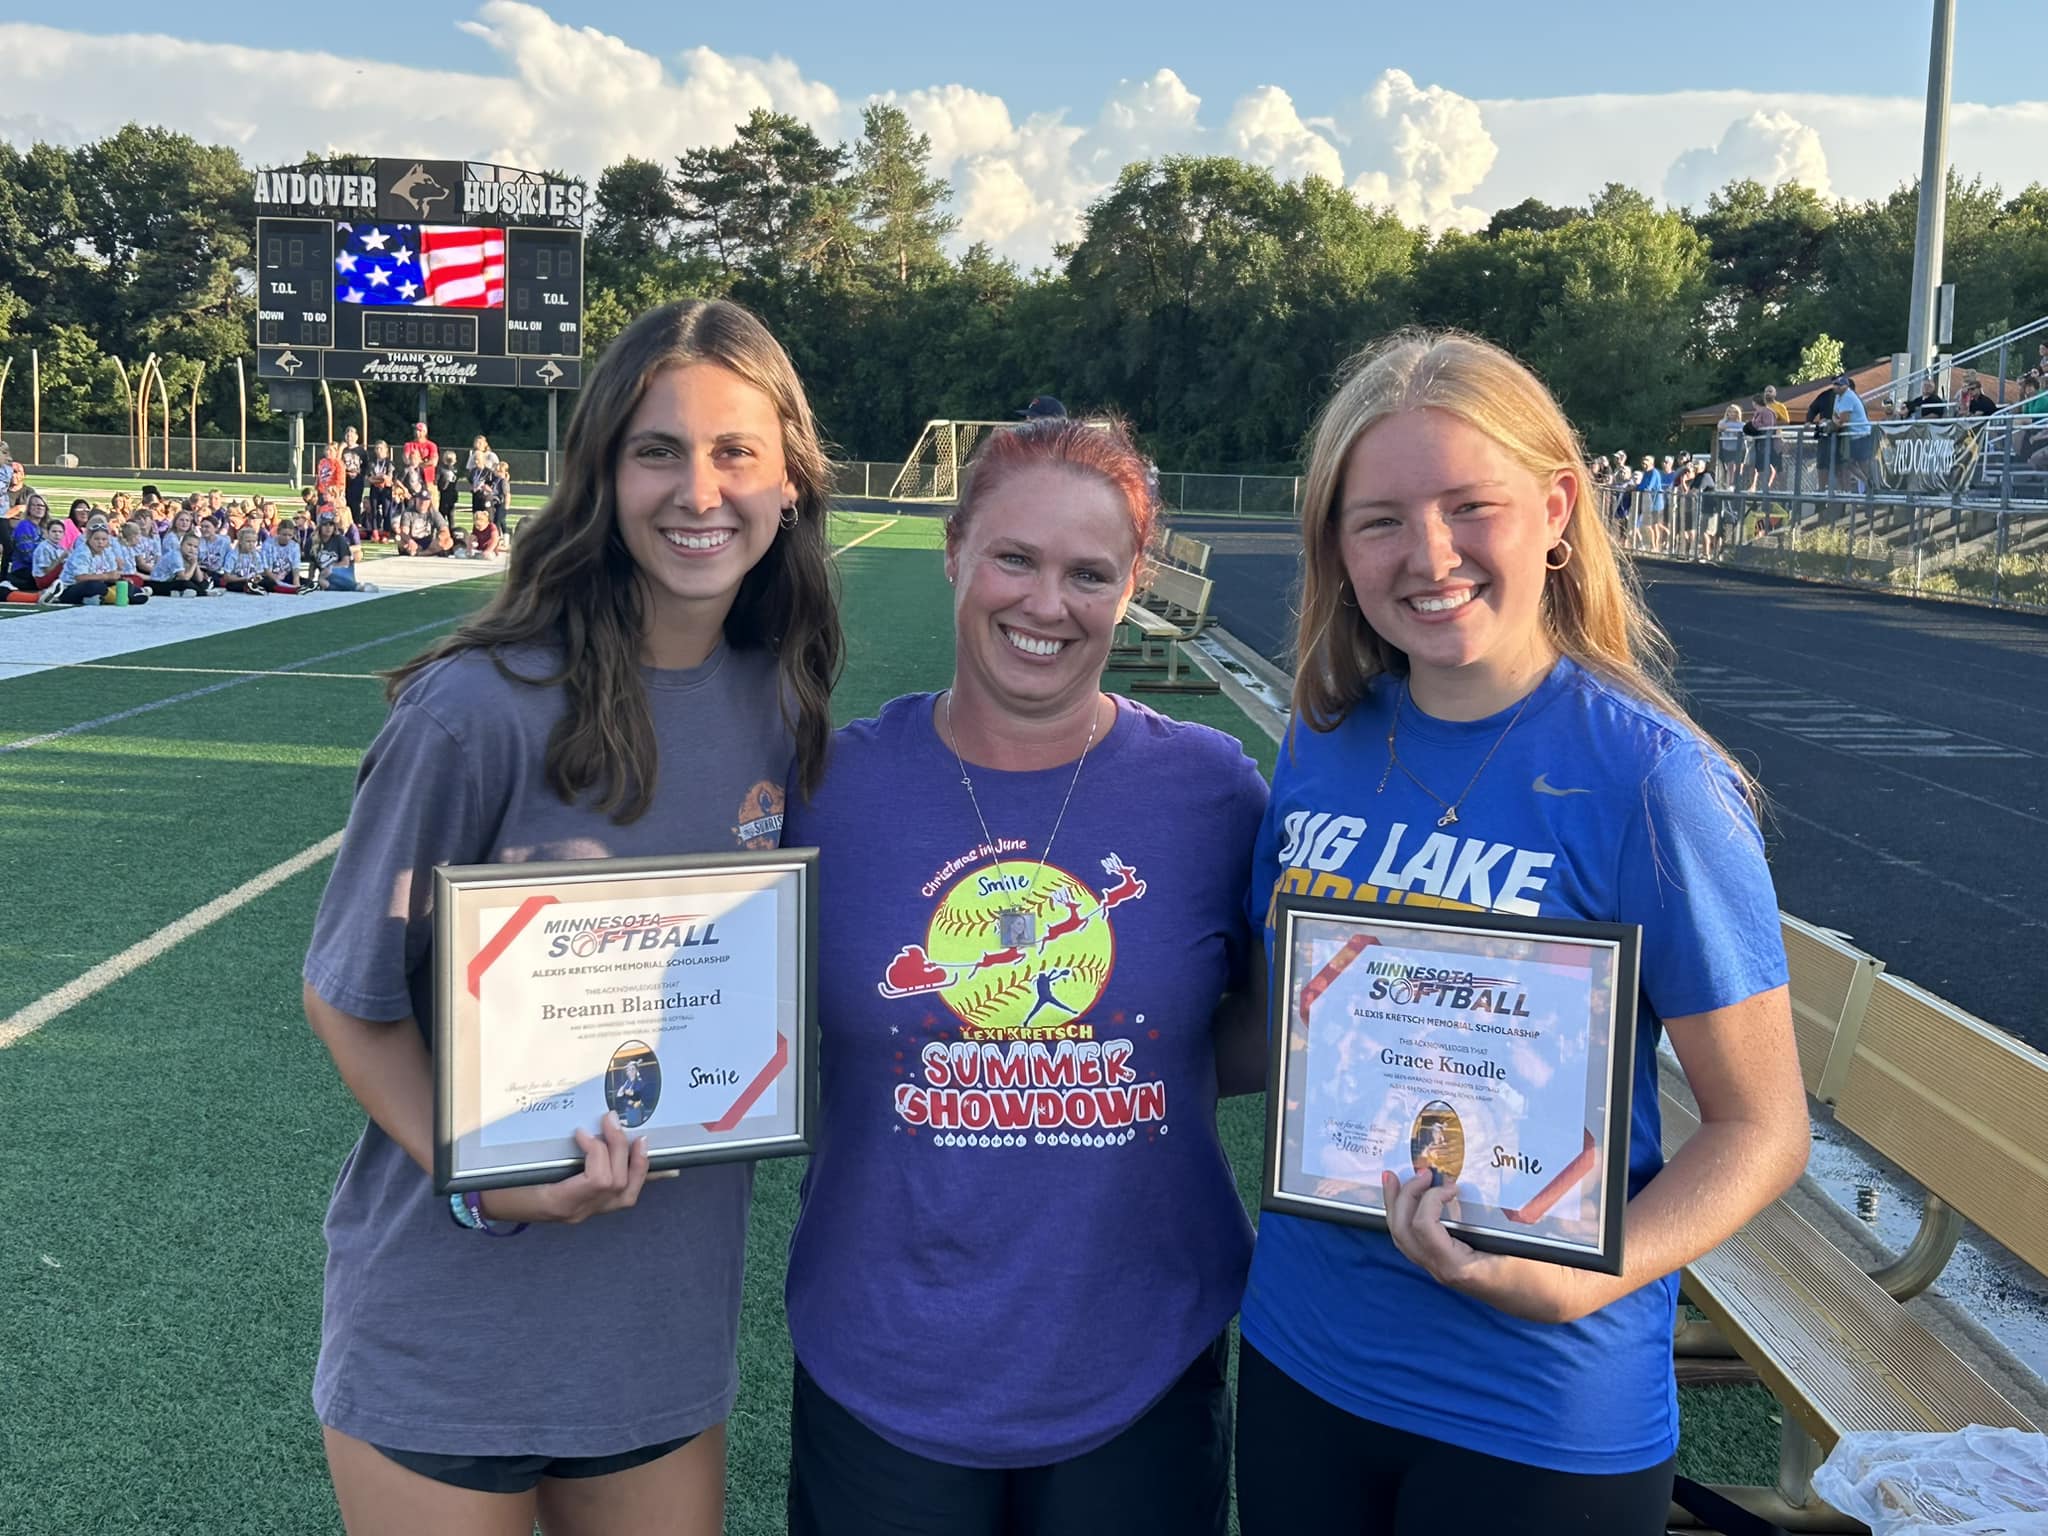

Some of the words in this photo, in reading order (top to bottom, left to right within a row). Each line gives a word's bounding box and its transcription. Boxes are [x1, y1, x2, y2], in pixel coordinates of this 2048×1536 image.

[254, 172, 376, 208] ANDOVER
[463, 181, 583, 217] HUSKIES
[271, 282, 296, 294] T.O.L.
[543, 293, 568, 305] T.O.L.
[260, 310, 284, 322] DOWN
[303, 312, 313, 323] TO
[314, 312, 327, 323] GO
[508, 320, 528, 332] BALL
[529, 321, 542, 332] ON
[560, 322, 577, 333] QTR
[363, 359, 419, 373] Andover
[423, 362, 477, 377] Football
[387, 353, 425, 362] THANK
[430, 354, 453, 364] YOU
[373, 373, 467, 384] ASSOCIATION
[921, 848, 978, 897] Christmas
[978, 844, 993, 857] in
[995, 838, 1027, 854] June
[1279, 811, 1367, 872] BIG
[1368, 822, 1555, 917] LAKE
[978, 875, 1029, 896] Smile
[544, 913, 661, 934] MINNESOTA
[548, 923, 719, 958] SOFTBALL
[531, 967, 567, 978] ALEXIS
[568, 964, 613, 975] KRETSCH
[614, 961, 664, 972] MEMORIAL
[666, 955, 730, 968] SCHOLARSHIP
[1366, 961, 1474, 987] MINNESOTA
[541, 1001, 615, 1021] Breann
[621, 989, 721, 1013] Blanchard
[1369, 977, 1530, 1018] SOFTBALL
[961, 1026, 1003, 1041] LEXI
[1006, 1025, 1094, 1040] KRETSCH
[1354, 1008, 1384, 1020] ALEXIS
[1385, 1013, 1425, 1025] KRETSCH
[1427, 1017, 1473, 1031] MEMORIAL
[1475, 1023, 1540, 1039] SCHOLARSHIP
[922, 1039, 1136, 1088] SUMMER
[1381, 1048, 1433, 1070] Grace
[1438, 1056, 1506, 1080] Knodle
[688, 1066, 739, 1089] Smile
[895, 1080, 1165, 1130] SHOWDOWN
[1490, 1145, 1543, 1175] Smile
